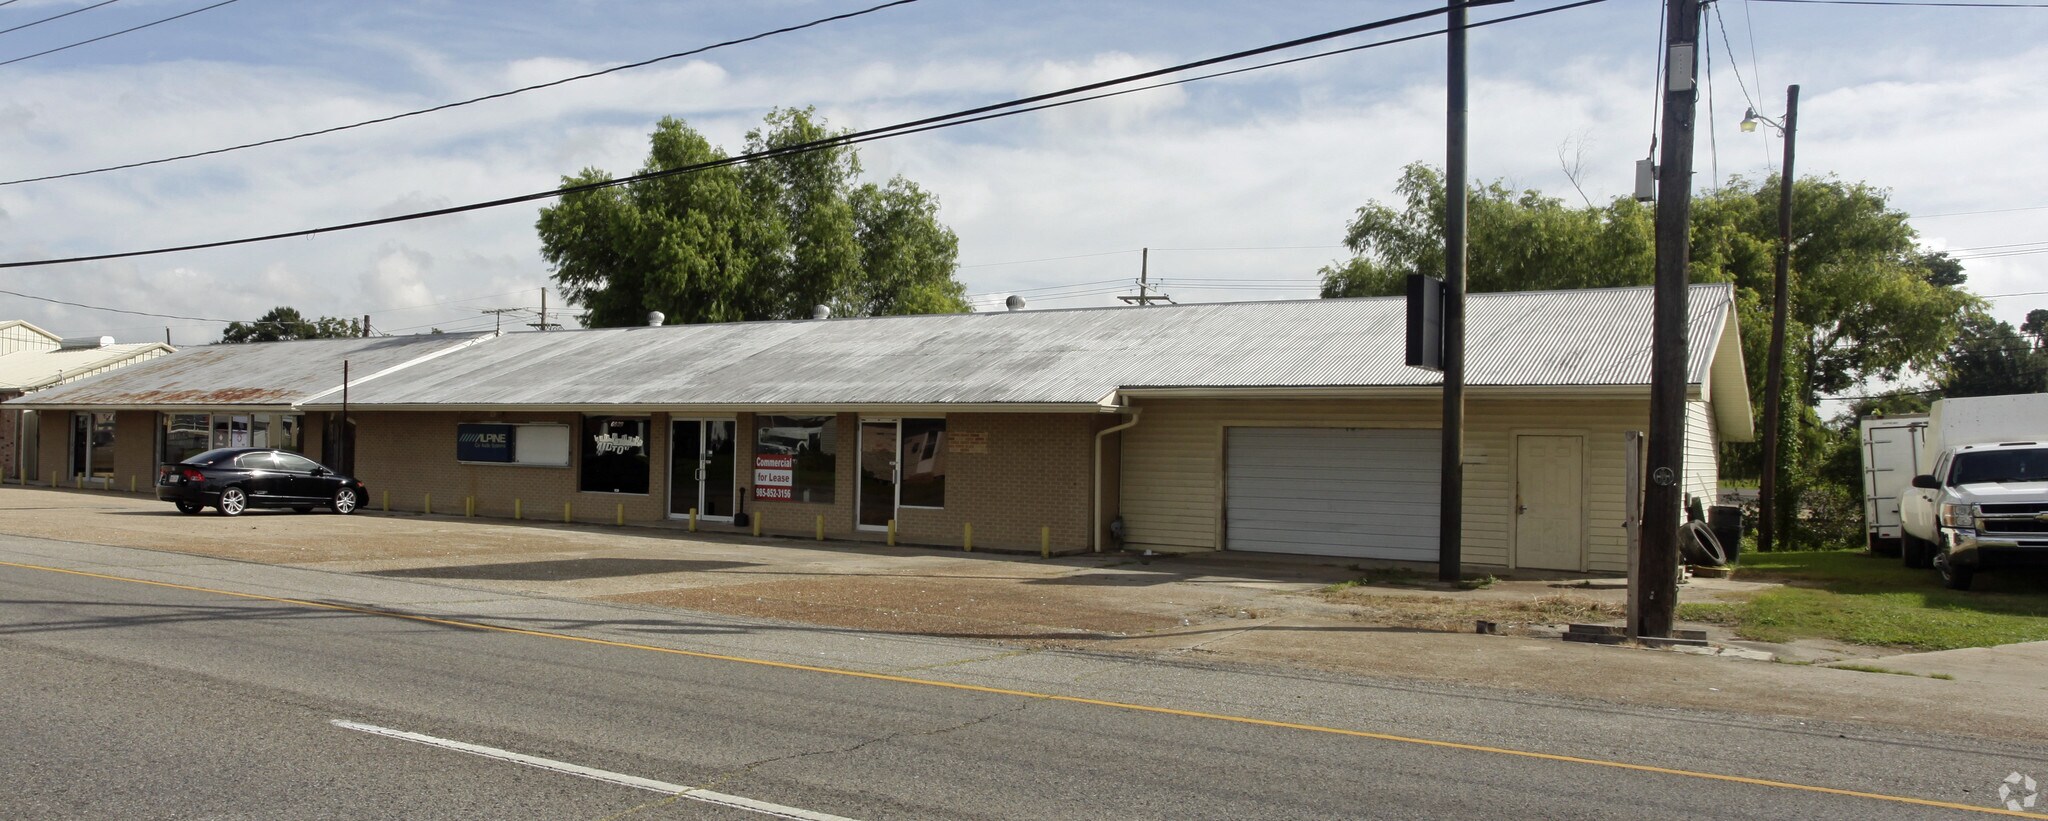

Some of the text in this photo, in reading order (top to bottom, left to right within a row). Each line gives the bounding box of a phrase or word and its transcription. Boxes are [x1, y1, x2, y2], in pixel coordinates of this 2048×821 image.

[474, 433, 507, 443] ALPINE
[756, 457, 792, 467] Commercial
[758, 472, 790, 482] for Lease
[756, 488, 791, 498] 985-852-3156
